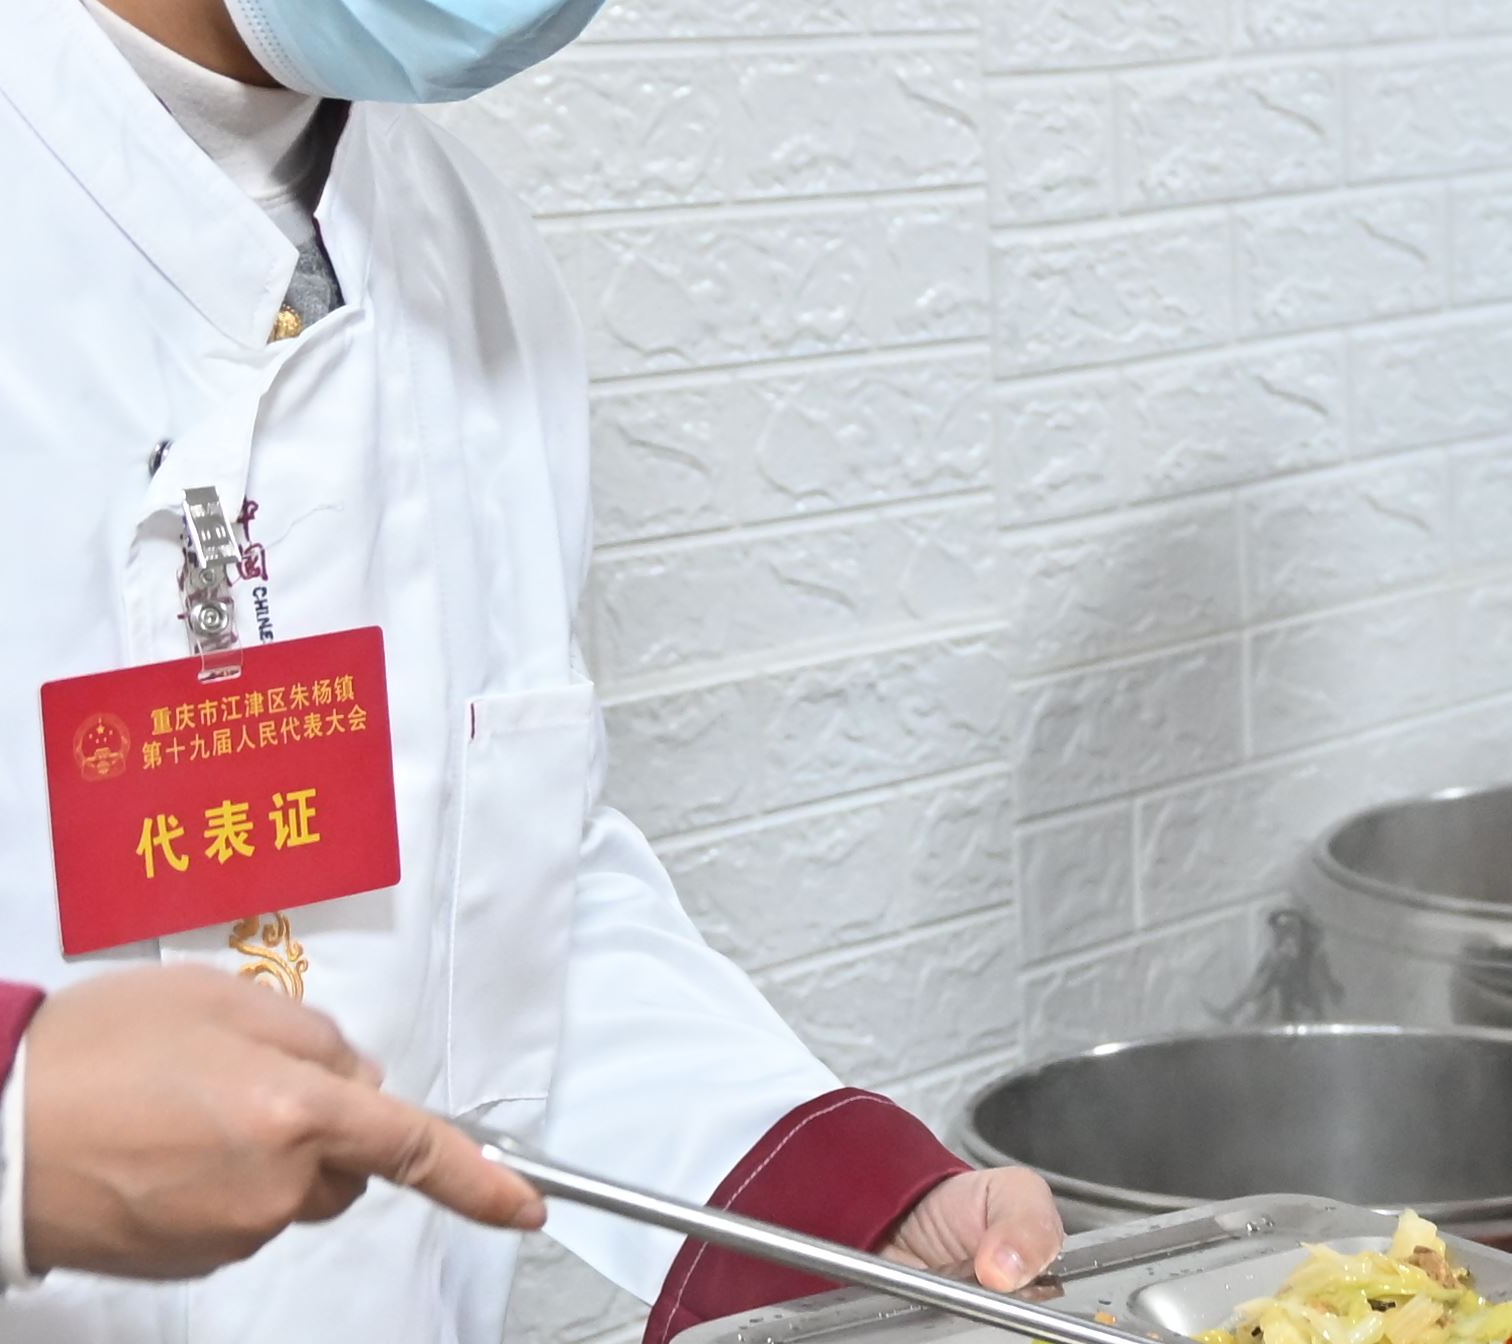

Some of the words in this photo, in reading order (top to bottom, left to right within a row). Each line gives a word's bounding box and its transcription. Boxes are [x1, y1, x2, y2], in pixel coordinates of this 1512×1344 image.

[252, 586, 274, 642] CHINE
[151, 674, 355, 735] 重庆市江津区朱杨镇
[142, 704, 367, 769] 第十九届人民代表大会
[136, 788, 321, 879] 代表证
